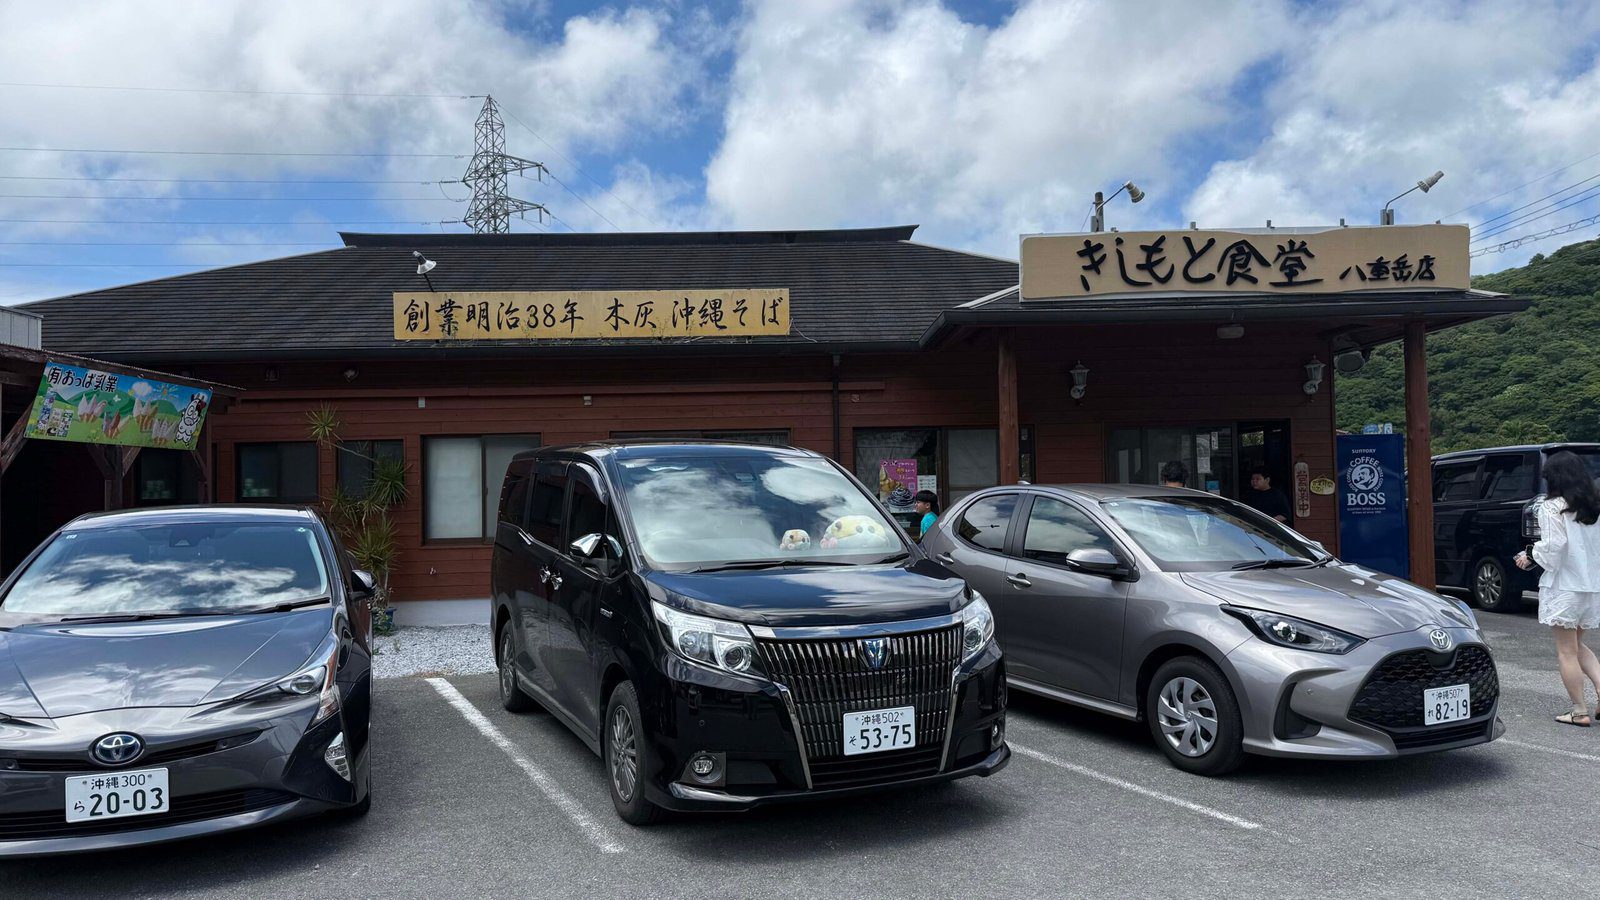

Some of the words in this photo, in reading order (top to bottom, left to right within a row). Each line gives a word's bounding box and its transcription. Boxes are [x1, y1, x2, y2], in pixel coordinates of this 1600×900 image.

[1076, 234, 1324, 292] きしもと食堂
[1339, 254, 1437, 282] 八重岳店
[403, 298, 585, 336] 創業明治38年
[604, 300, 659, 329] 木灰
[671, 297, 783, 332] 沖縄そば
[1349, 456, 1380, 468] COFFEE
[1346, 492, 1386, 506] BOSS
[861, 711, 900, 726] 沖縄502
[848, 735, 857, 746] そ
[860, 723, 912, 750] 53-75
[91, 773, 146, 790] 沖縄300
[73, 800, 85, 813] ら
[89, 787, 163, 817] 20-03
